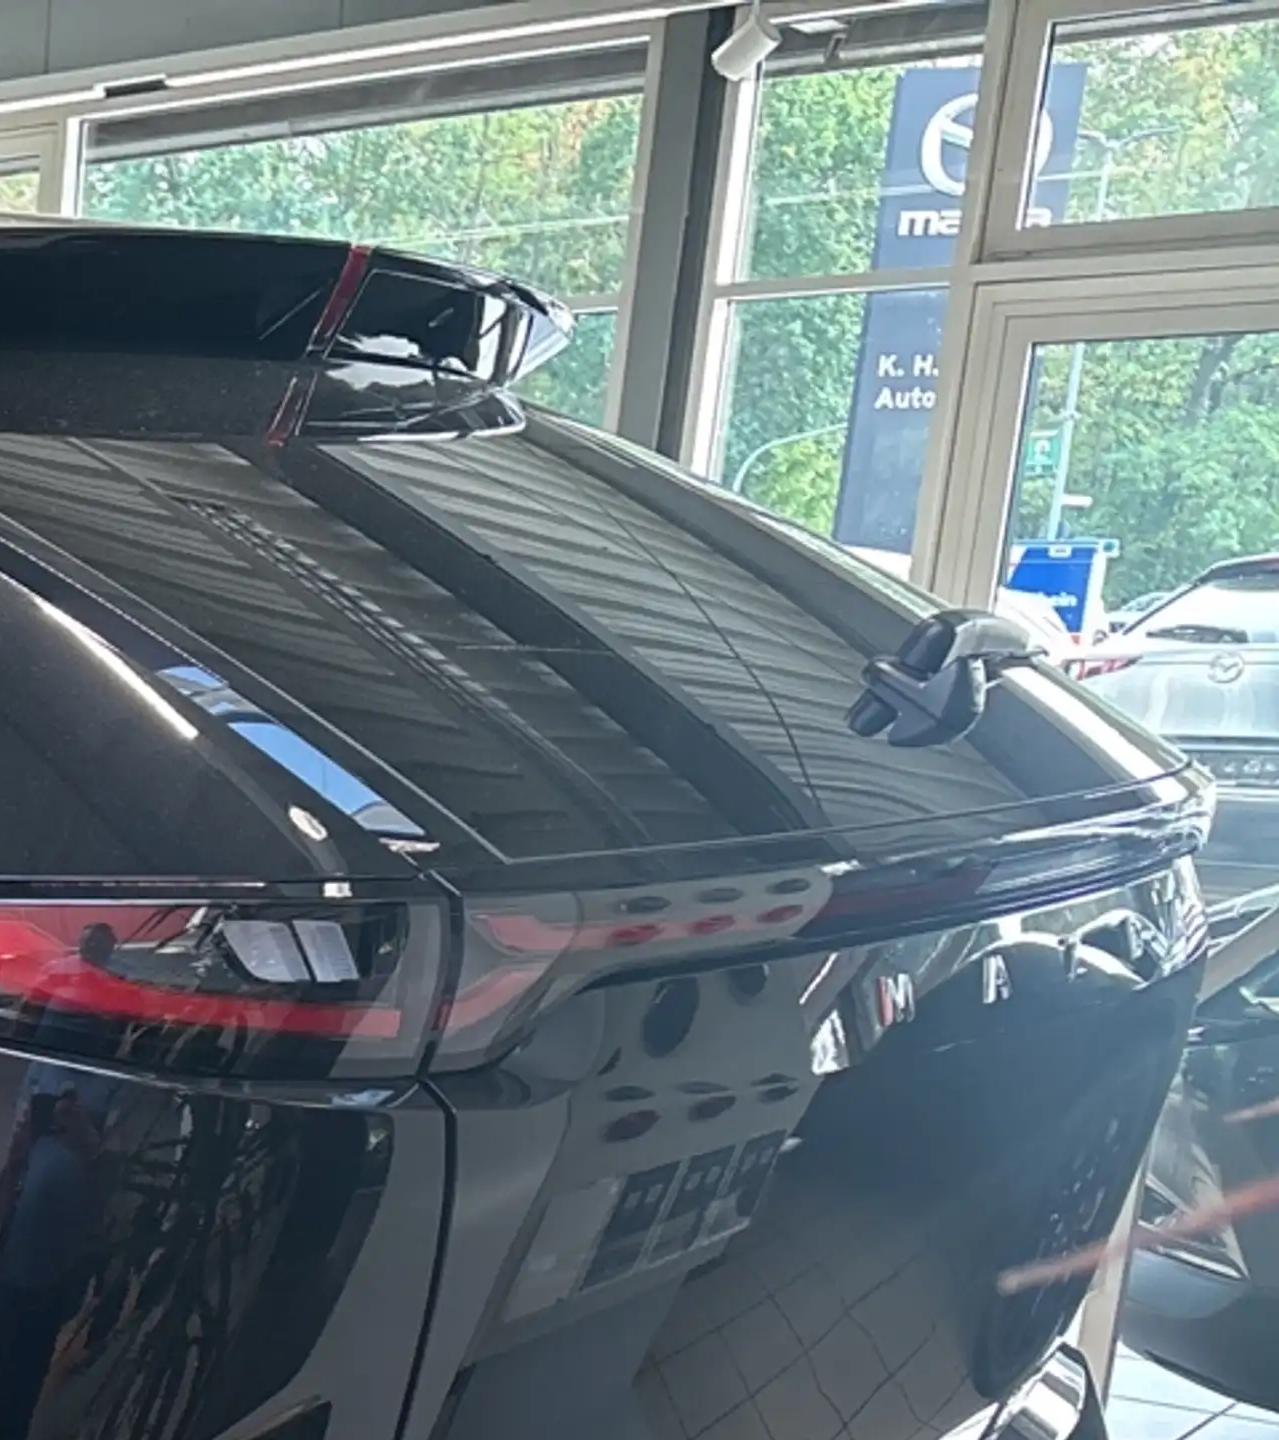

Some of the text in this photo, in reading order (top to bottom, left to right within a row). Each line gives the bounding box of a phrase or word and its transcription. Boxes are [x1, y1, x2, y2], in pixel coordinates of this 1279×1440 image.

[898, 208, 1052, 236] maa
[878, 354, 939, 377] K. H.
